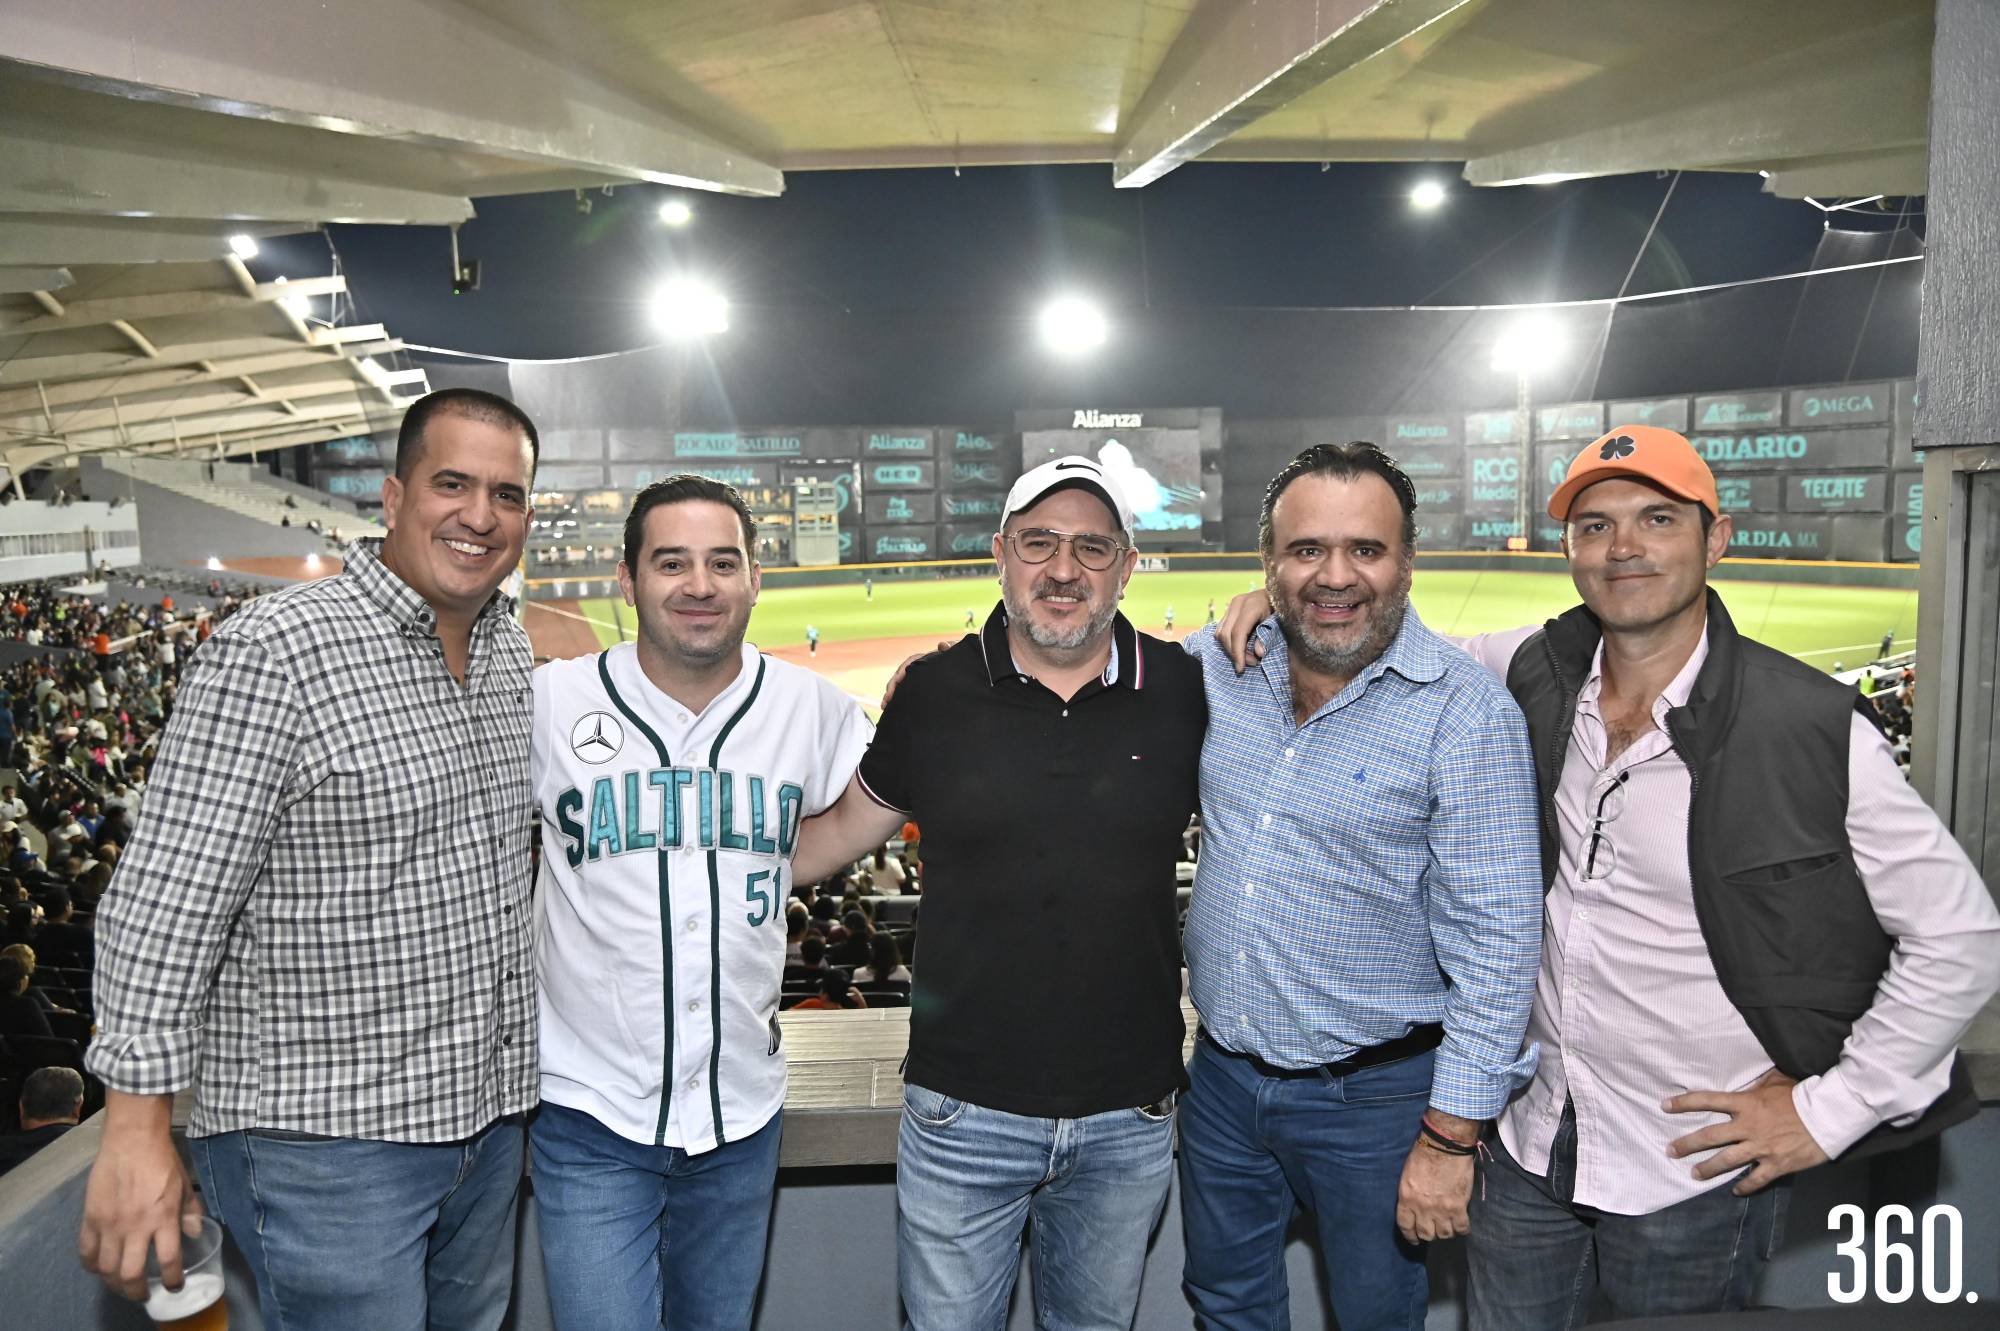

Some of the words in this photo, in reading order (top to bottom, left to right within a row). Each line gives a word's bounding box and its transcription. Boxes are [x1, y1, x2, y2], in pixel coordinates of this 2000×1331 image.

[1072, 410, 1142, 428] Alianza
[1396, 423, 1448, 438] Alianza
[740, 437, 800, 451] SALTILLO
[869, 434, 925, 450] Alianza
[1706, 435, 1807, 460] DIARIO
[1473, 458, 1519, 483] RCG
[1801, 478, 1868, 498] TECATE
[555, 766, 803, 871] SALTILLO
[746, 867, 781, 927] 51
